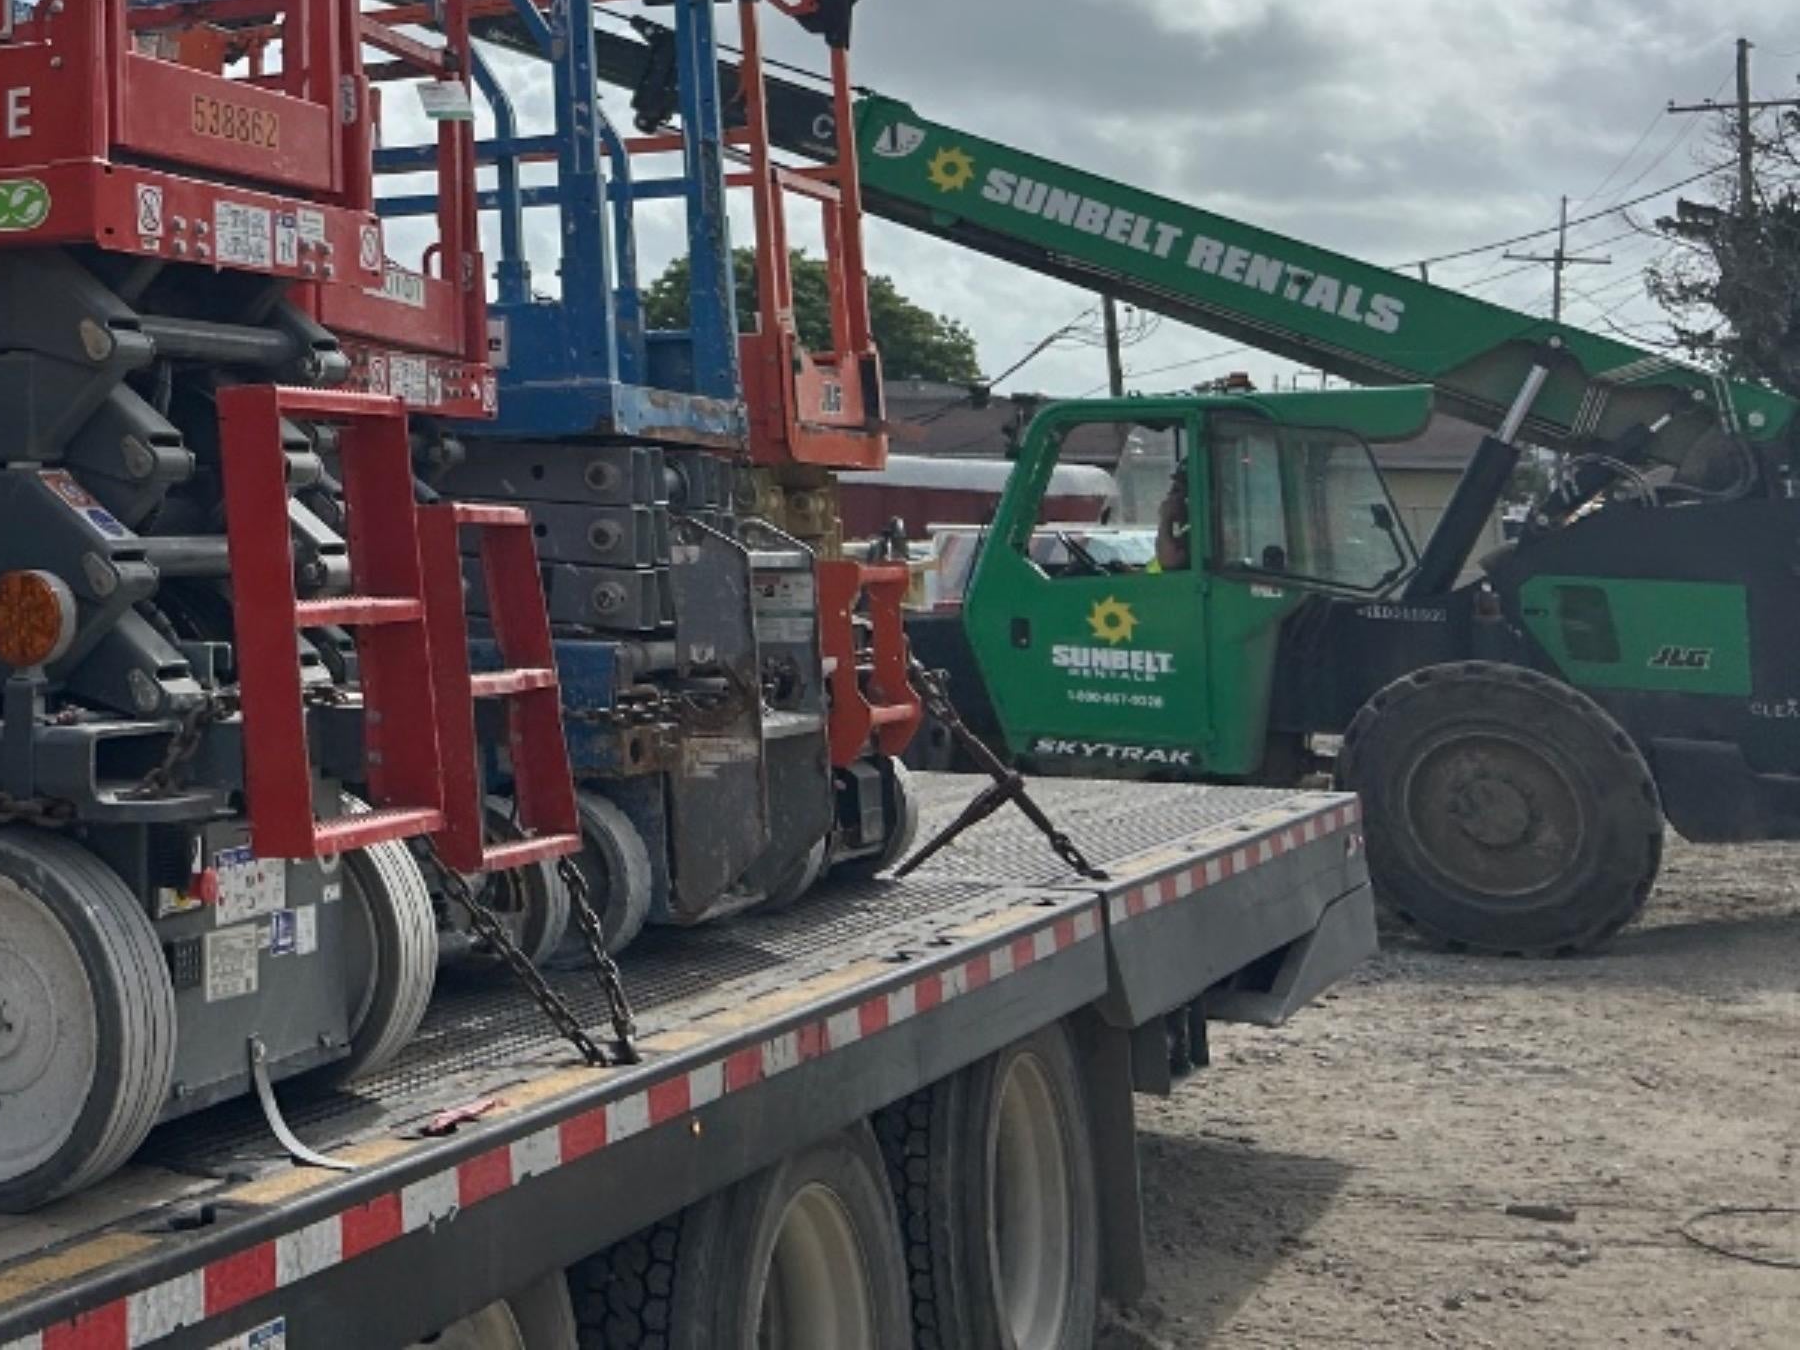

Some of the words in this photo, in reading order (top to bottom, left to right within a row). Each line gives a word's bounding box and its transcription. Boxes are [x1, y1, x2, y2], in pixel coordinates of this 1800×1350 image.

[7, 87, 31, 139] E
[194, 96, 278, 148] 538862
[981, 168, 1183, 259] SUNBELT
[1185, 234, 1405, 334] RENTALS
[1052, 644, 1174, 673] SUNBELT
[1035, 739, 1193, 766] SKYTRAK
